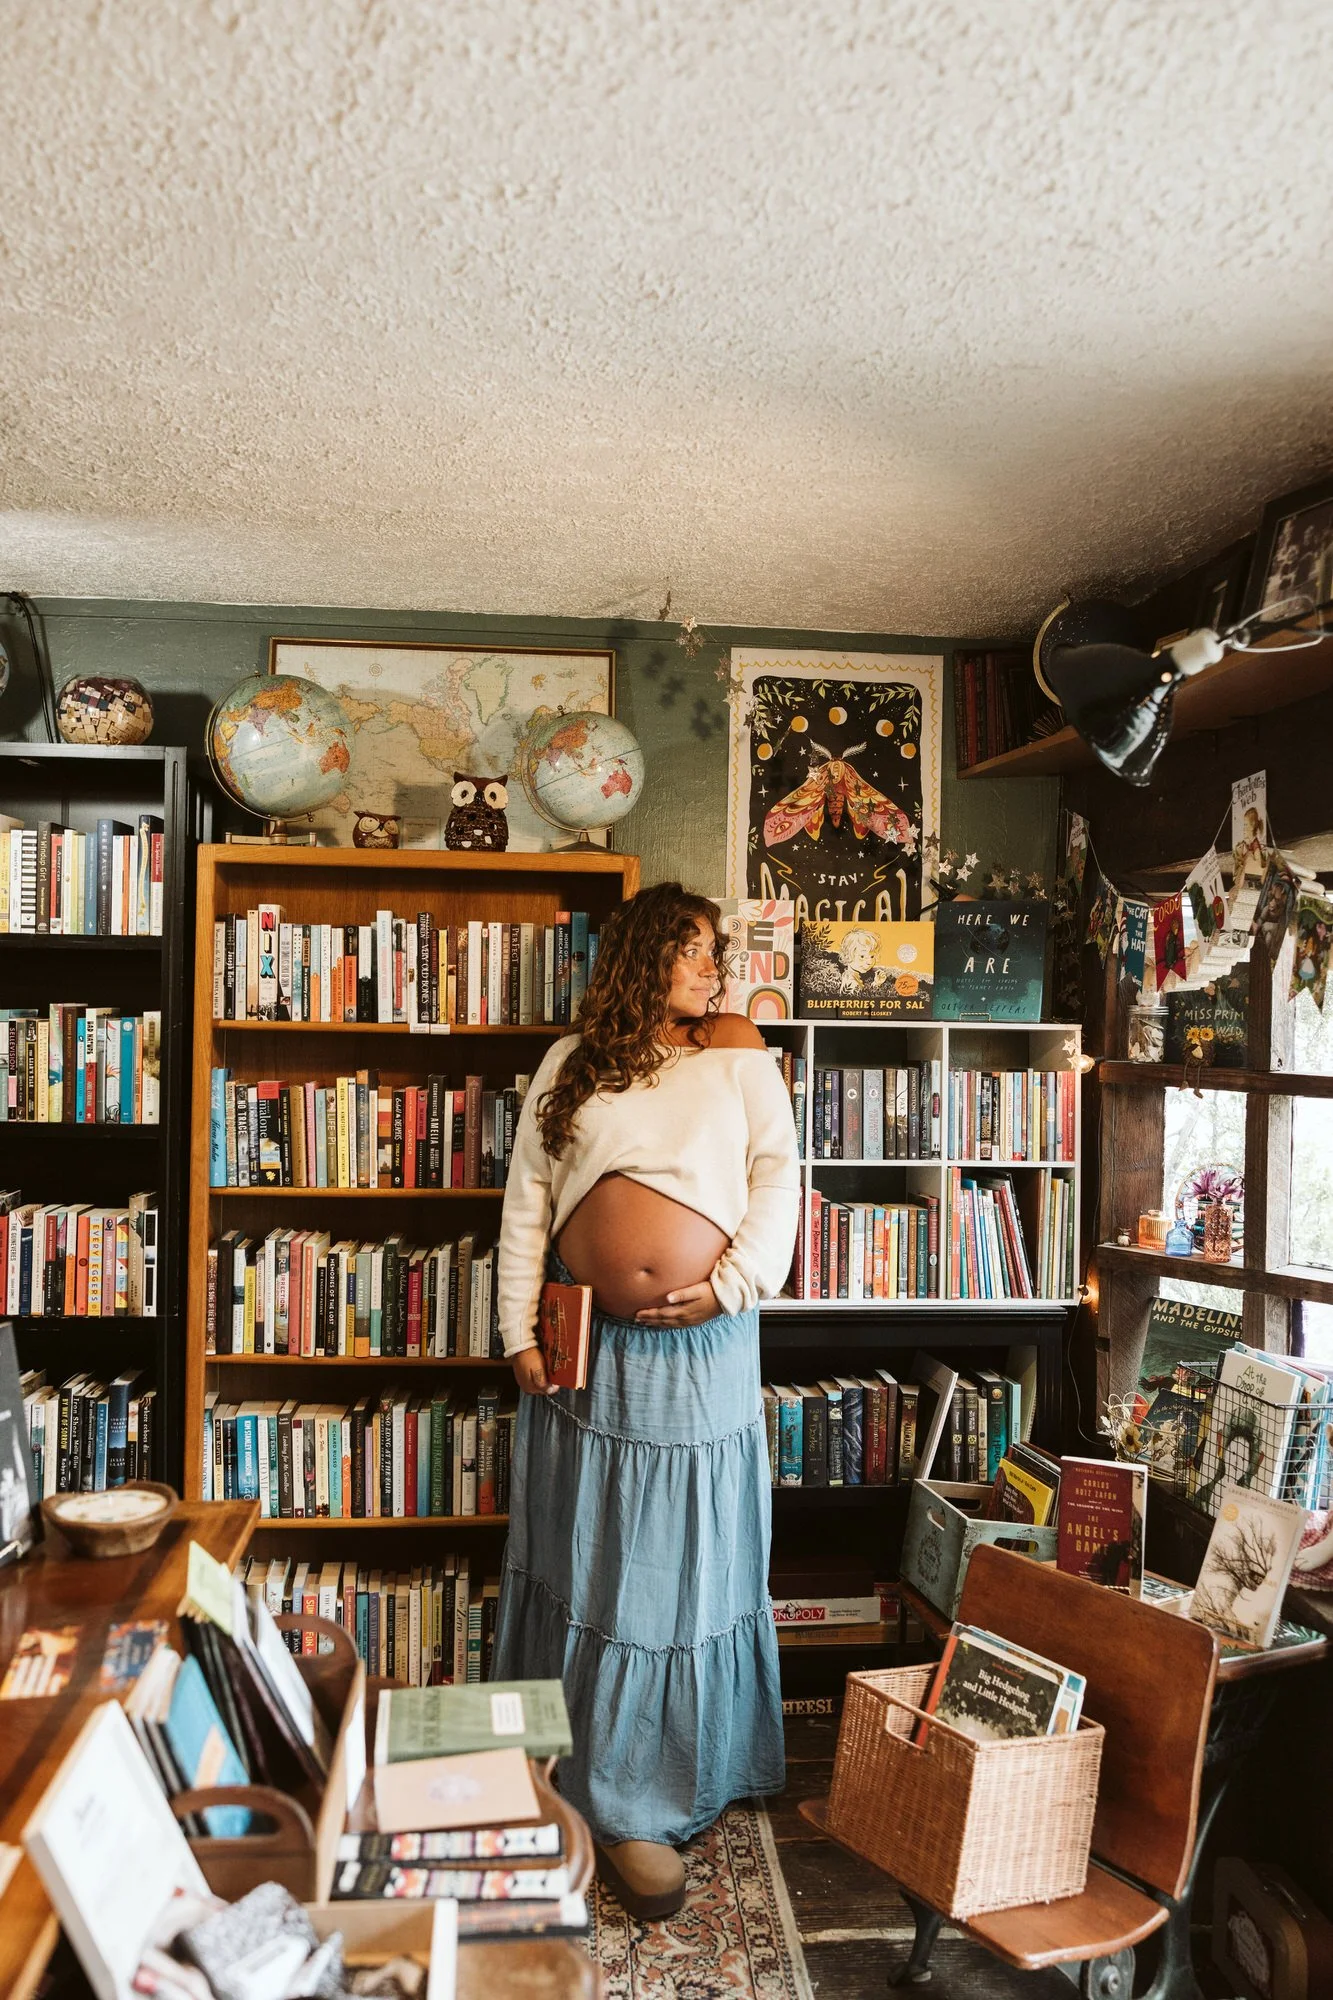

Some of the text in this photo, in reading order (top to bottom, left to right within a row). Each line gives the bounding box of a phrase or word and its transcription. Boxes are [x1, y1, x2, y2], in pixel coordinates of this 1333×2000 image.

[1241, 790, 1256, 808] Web
[818, 873, 858, 886] STAY
[958, 914, 1030, 926] HERE WE
[1135, 907, 1148, 919] CAT
[261, 911, 276, 979] NIX
[1131, 938, 1145, 952] HAT
[964, 957, 1010, 974] ARE
[421, 980, 429, 1004] BONES
[807, 1000, 924, 1010] BLUEBERRIES FOR SAL
[1184, 1006, 1244, 1020] MISS PRIM
[237, 1100, 246, 1135] NO TRACE
[259, 1100, 271, 1138] malone
[328, 1114, 336, 1145] LIFE PI
[430, 1117, 439, 1145] AMELIA
[830, 1241, 838, 1269] Olivetti
[278, 1258, 287, 1319] RESURRECTIONIST
[329, 1289, 335, 1297] OF
[1152, 1298, 1242, 1329] MADELIN
[1153, 1314, 1175, 1324] AND
[1180, 1320, 1199, 1329] THE
[1236, 1376, 1254, 1392] Drop
[1243, 1365, 1267, 1385] At the
[385, 1416, 391, 1427] SO
[432, 1411, 442, 1439] AWKWARD
[385, 1449, 391, 1459] AT
[992, 1440, 1001, 1463] HERO
[260, 1457, 268, 1491] HOME
[432, 1449, 442, 1482] FRANCESCA
[244, 1480, 252, 1500] 2140
[1075, 1488, 1091, 1497] RUIZ
[1083, 1479, 1109, 1489] CARLOS
[1067, 1522, 1119, 1541] ANGEL'S
[456, 1608, 467, 1633] Zero
[773, 1609, 824, 1621] ONOPOLY
[306, 1632, 315, 1647] FUN
[978, 1669, 1030, 1704] Big Hedgehog
[962, 1681, 1037, 1724] and Little Hedgehog
